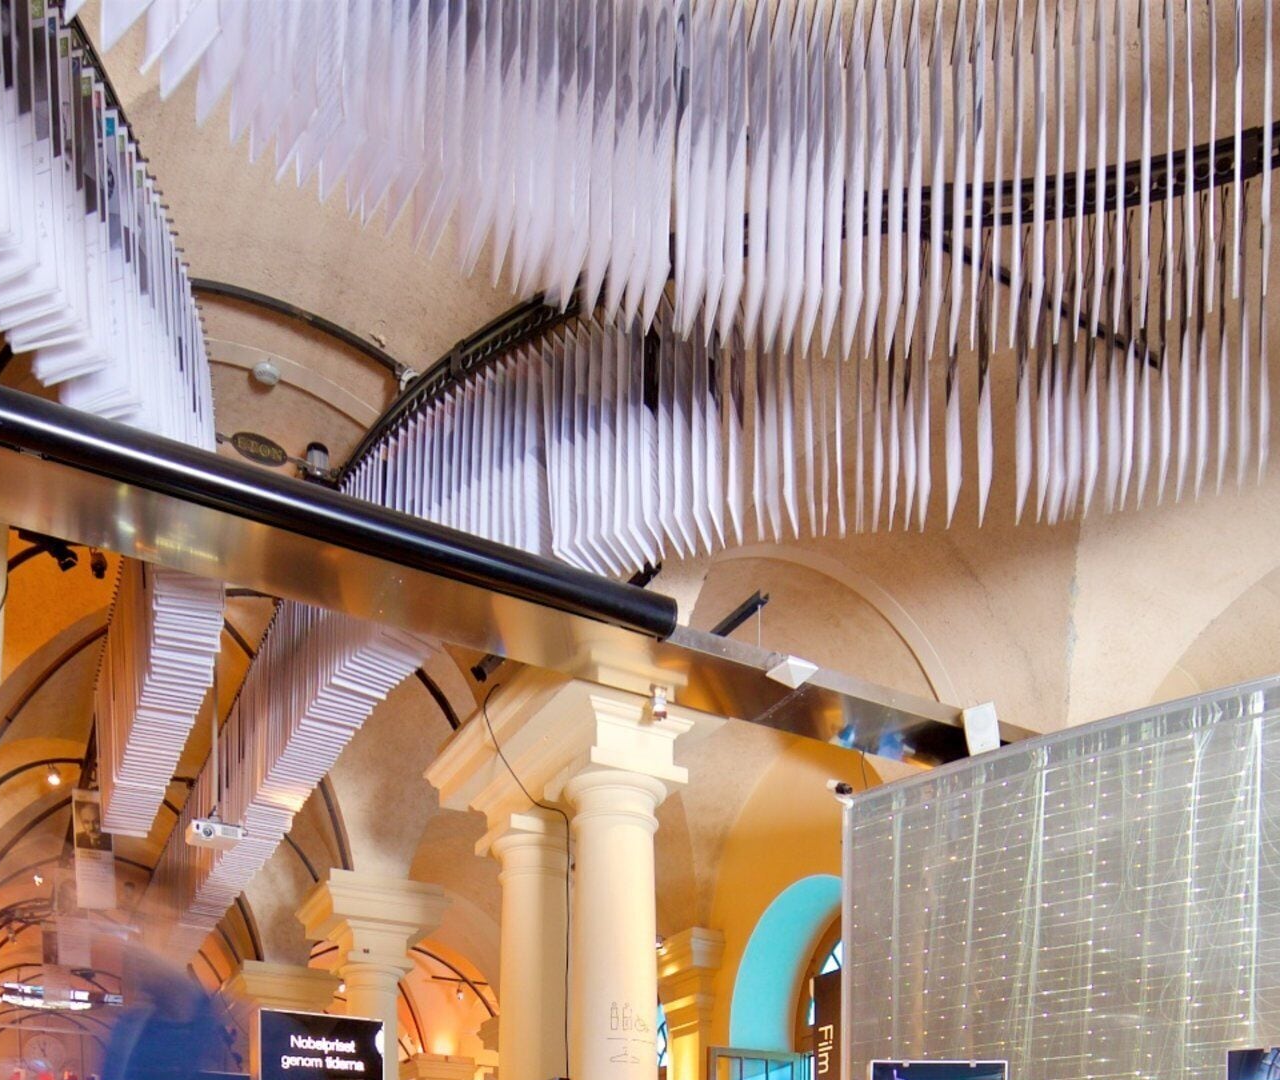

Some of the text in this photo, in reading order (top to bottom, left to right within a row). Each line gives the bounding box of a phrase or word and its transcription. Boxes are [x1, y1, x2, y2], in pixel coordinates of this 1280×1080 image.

[289, 1034, 356, 1055] Nobelpriset
[818, 1024, 834, 1075] Film
[280, 1055, 365, 1072] genom tiderna
